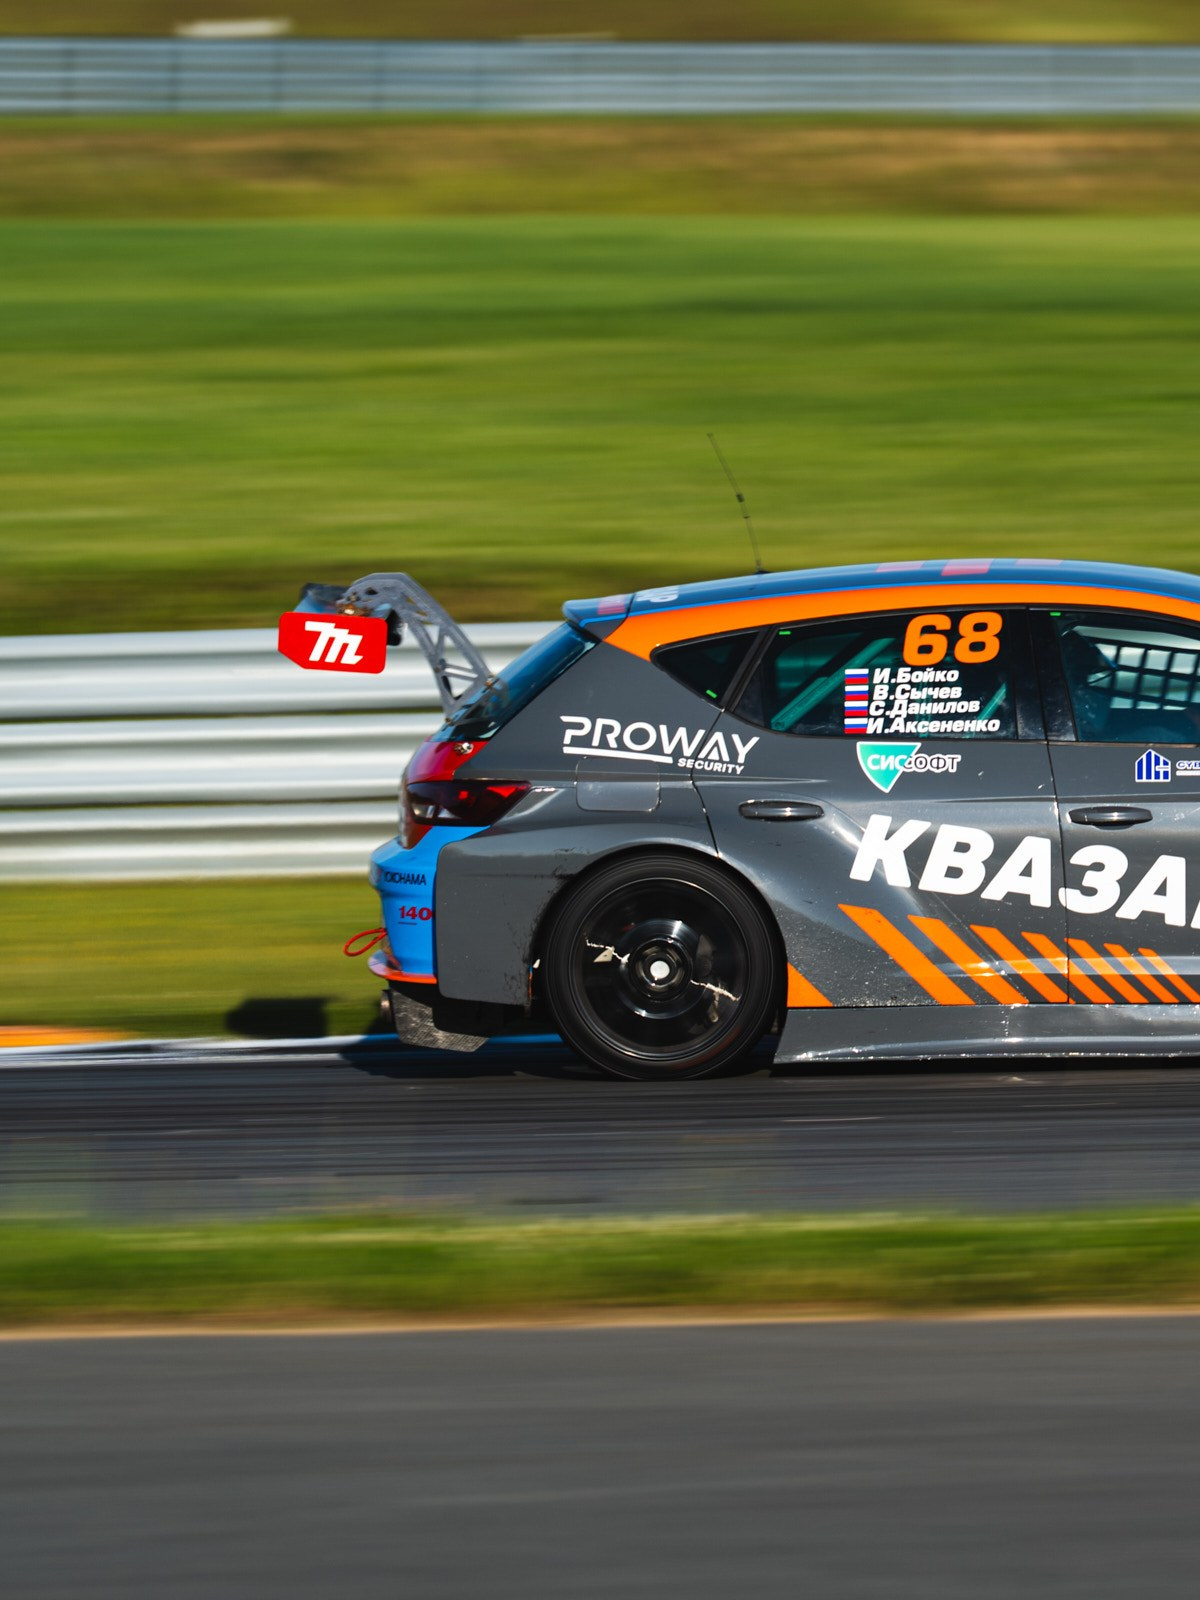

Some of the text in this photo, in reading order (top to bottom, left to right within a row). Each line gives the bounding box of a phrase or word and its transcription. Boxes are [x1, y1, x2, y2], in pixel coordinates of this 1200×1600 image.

[902, 611, 1003, 667] 68
[872, 667, 960, 684] И.Бойко
[872, 684, 963, 700] В.Сычев
[868, 699, 981, 718] С.Данилов
[865, 716, 1001, 734] И.Аксененко
[559, 715, 761, 764] PROWAY
[677, 757, 744, 775] SECURITY
[399, 905, 433, 921] 140
